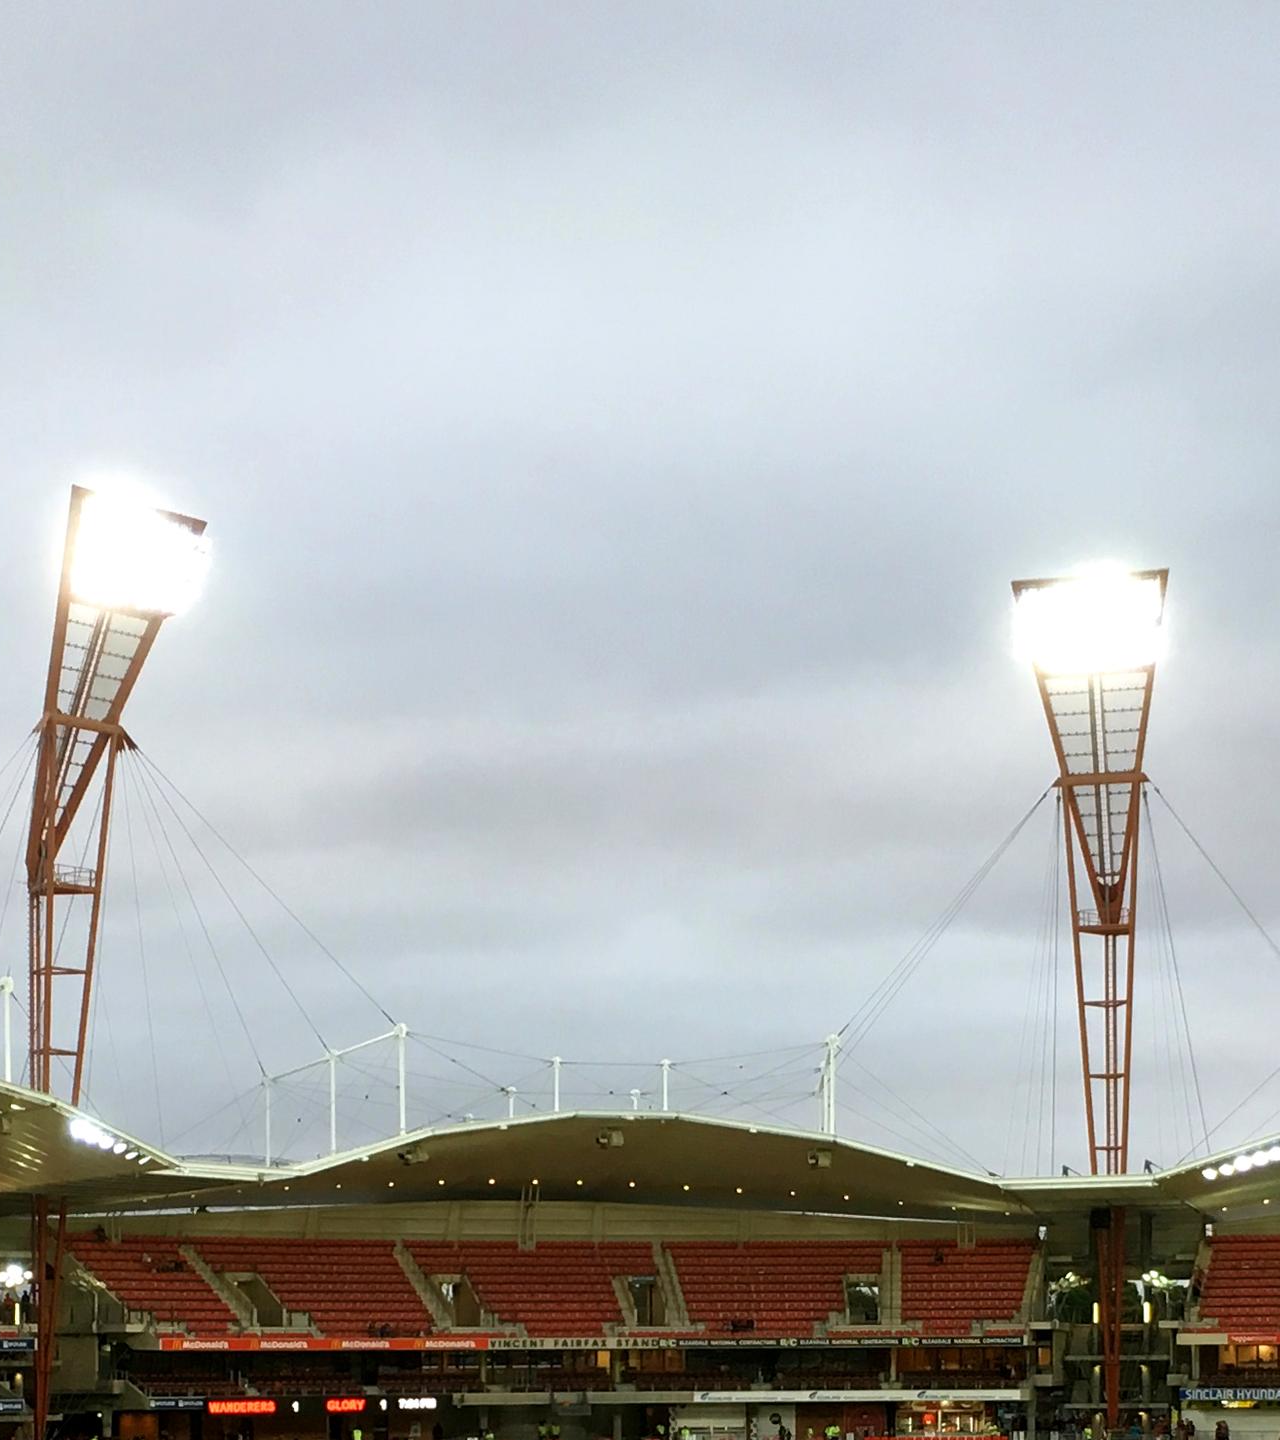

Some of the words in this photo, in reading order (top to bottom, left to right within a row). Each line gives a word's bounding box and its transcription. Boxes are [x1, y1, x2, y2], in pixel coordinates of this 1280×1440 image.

[182, 1339, 229, 1349] McDonald's
[260, 1340, 308, 1349] McDonald's
[342, 1340, 390, 1349] McDonald's
[425, 1340, 476, 1348] McDonald's
[490, 1339, 545, 1348] VINCENT
[553, 1339, 607, 1348] FAIRFAX
[616, 1339, 659, 1347] STAND
[1185, 1389, 1233, 1400] SINCLAIR
[207, 1399, 276, 1413] WANDERERS
[291, 1400, 299, 1413] 1
[326, 1399, 366, 1411] GLORY
